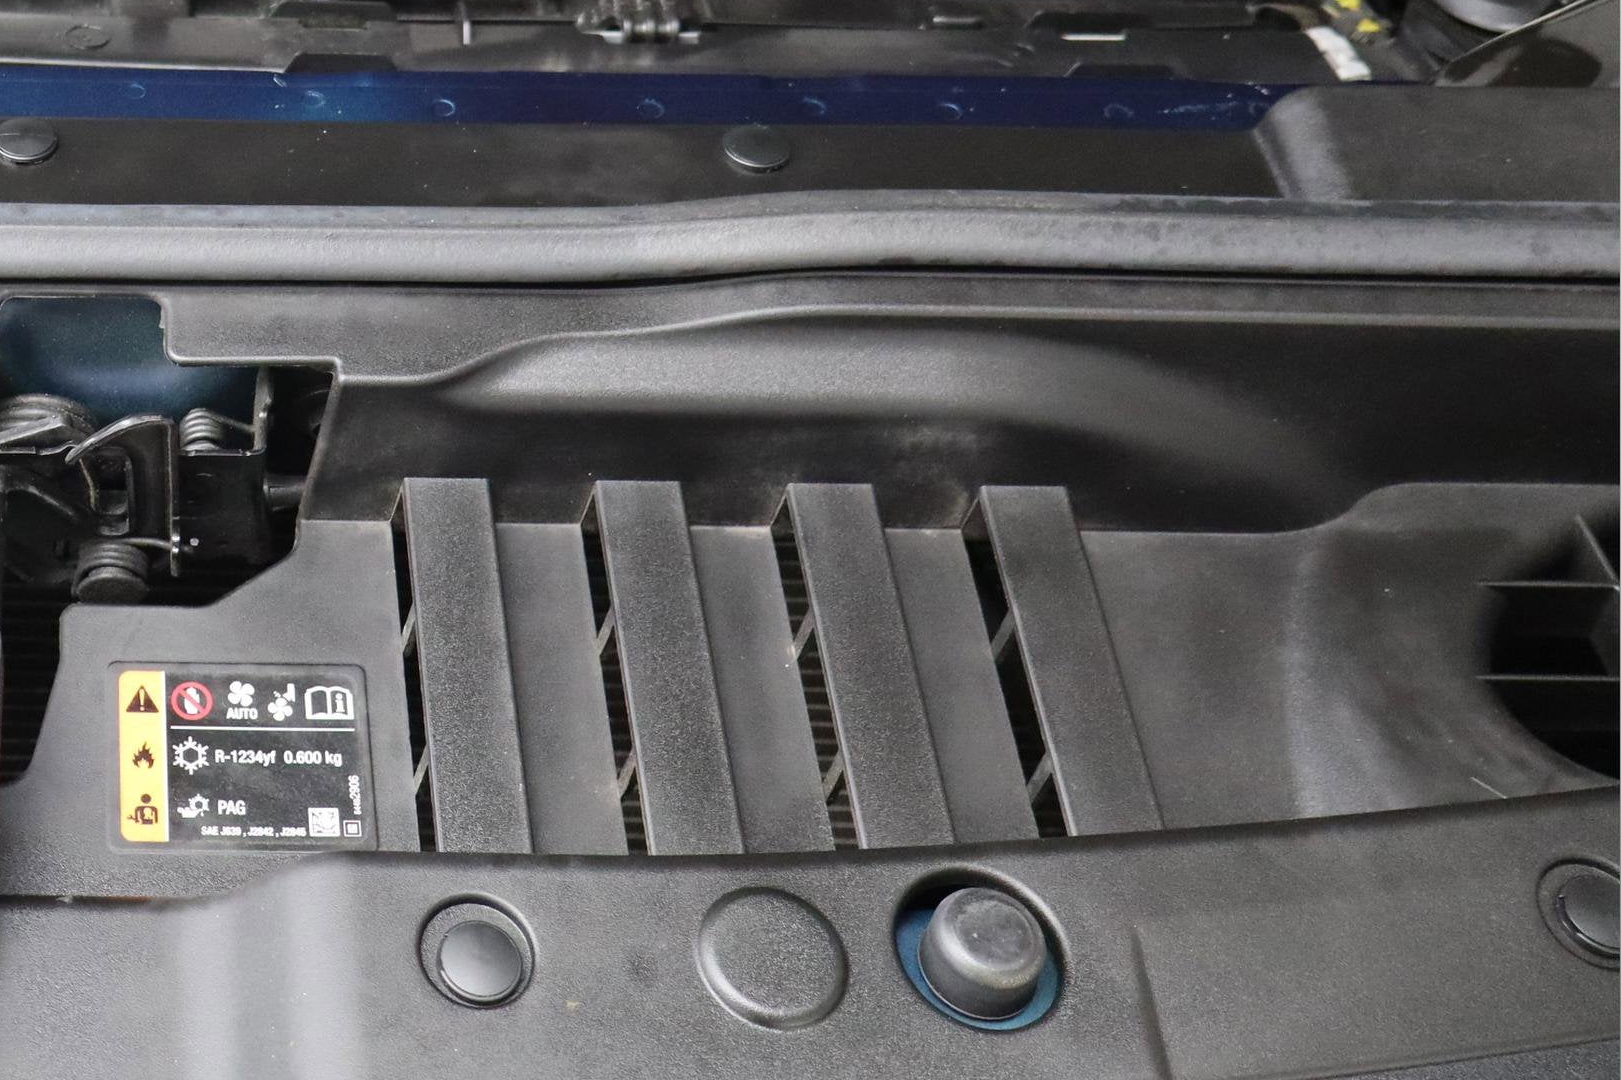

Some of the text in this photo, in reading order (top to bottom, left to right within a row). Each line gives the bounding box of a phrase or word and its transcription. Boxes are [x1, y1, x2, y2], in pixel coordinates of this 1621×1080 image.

[226, 707, 258, 721] AUTO
[214, 749, 343, 767] R-1234yf 0.600 kg
[218, 799, 246, 816] PAG
[200, 826, 219, 837] SAE
